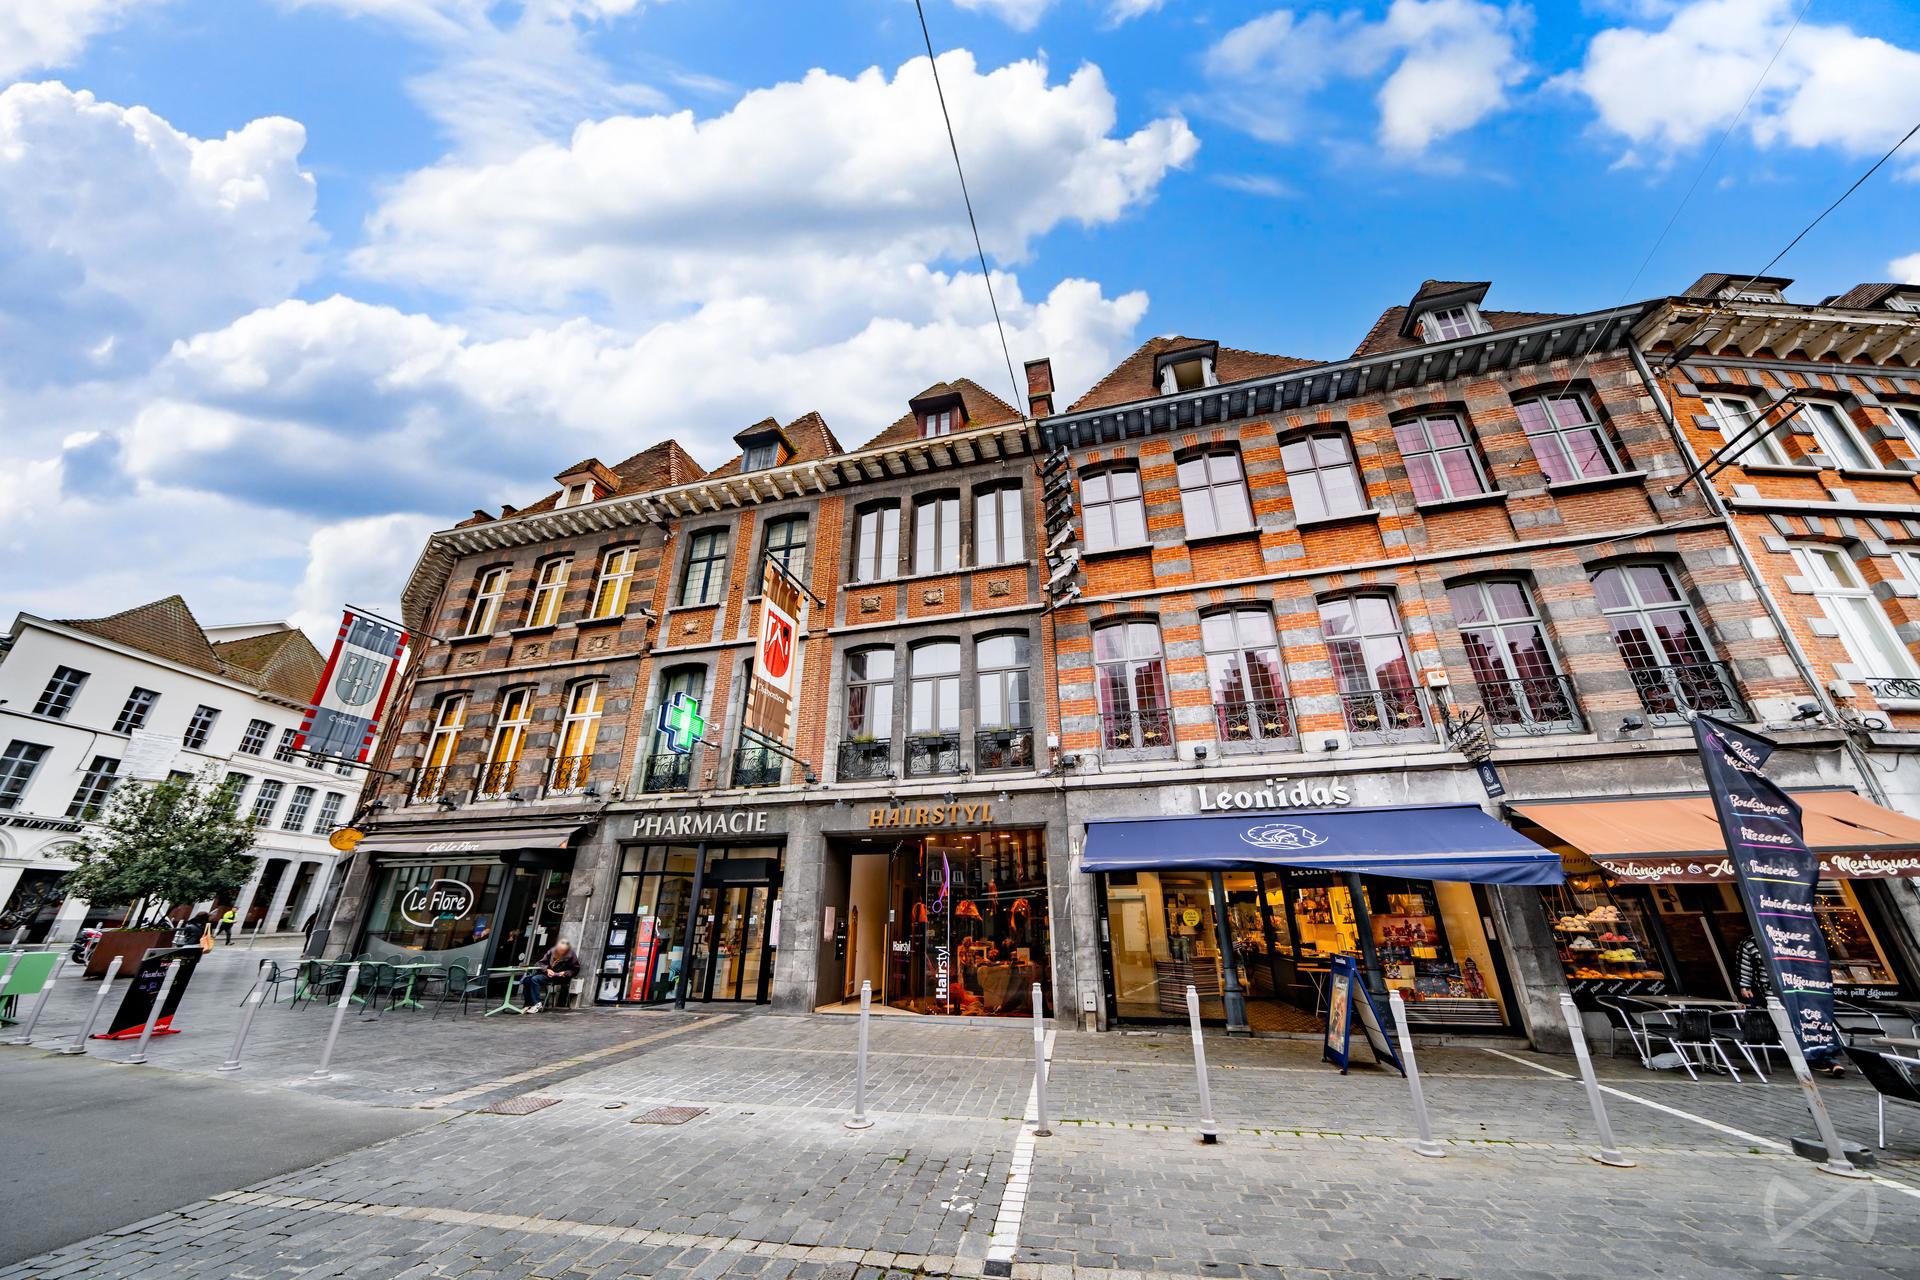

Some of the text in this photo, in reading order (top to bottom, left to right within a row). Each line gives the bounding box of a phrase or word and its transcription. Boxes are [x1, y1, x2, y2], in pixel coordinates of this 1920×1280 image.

[1197, 778, 1351, 811] Leonidas
[632, 811, 767, 837] PHARMACIE
[868, 803, 993, 827] HAIRSTYL
[1740, 826, 1793, 844] Ptisserie
[1831, 854, 1920, 876] Meringues
[409, 891, 466, 911] Le Flore
[893, 940, 911, 955] Hairstyl
[935, 946, 951, 999] Hairstyl
[1833, 986, 1848, 996] otre
[1850, 987, 1867, 998] petit
